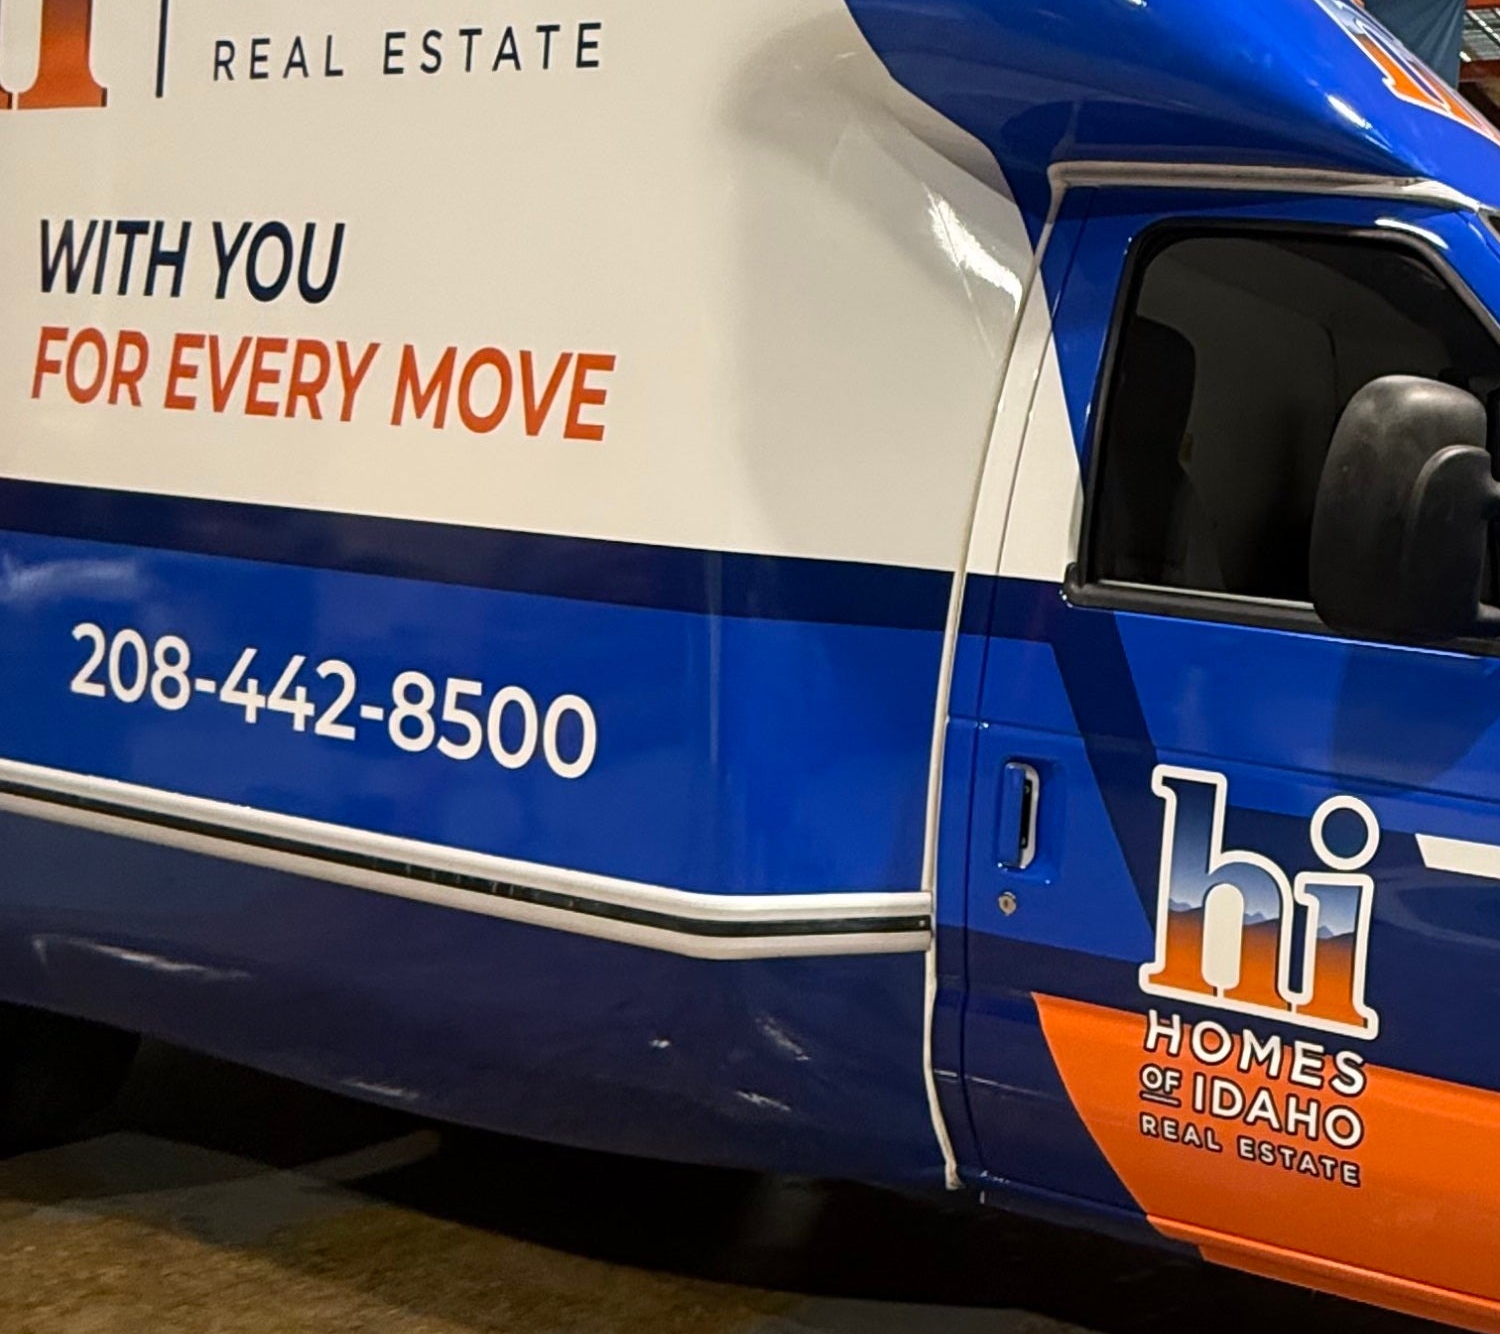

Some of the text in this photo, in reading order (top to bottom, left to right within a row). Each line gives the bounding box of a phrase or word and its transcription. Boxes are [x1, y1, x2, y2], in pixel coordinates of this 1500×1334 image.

[213, 22, 602, 81] REAL ESTATE
[40, 219, 346, 303] WITH YOU
[31, 326, 616, 441] FOR EVERY MOVE
[70, 623, 597, 779] 208-442-8500
[1138, 764, 1380, 1040] hi
[1145, 1010, 1366, 1097] HOMES
[1141, 1065, 1364, 1148] OF IDAHO
[1141, 1114, 1361, 1186] REAL ESTATE
